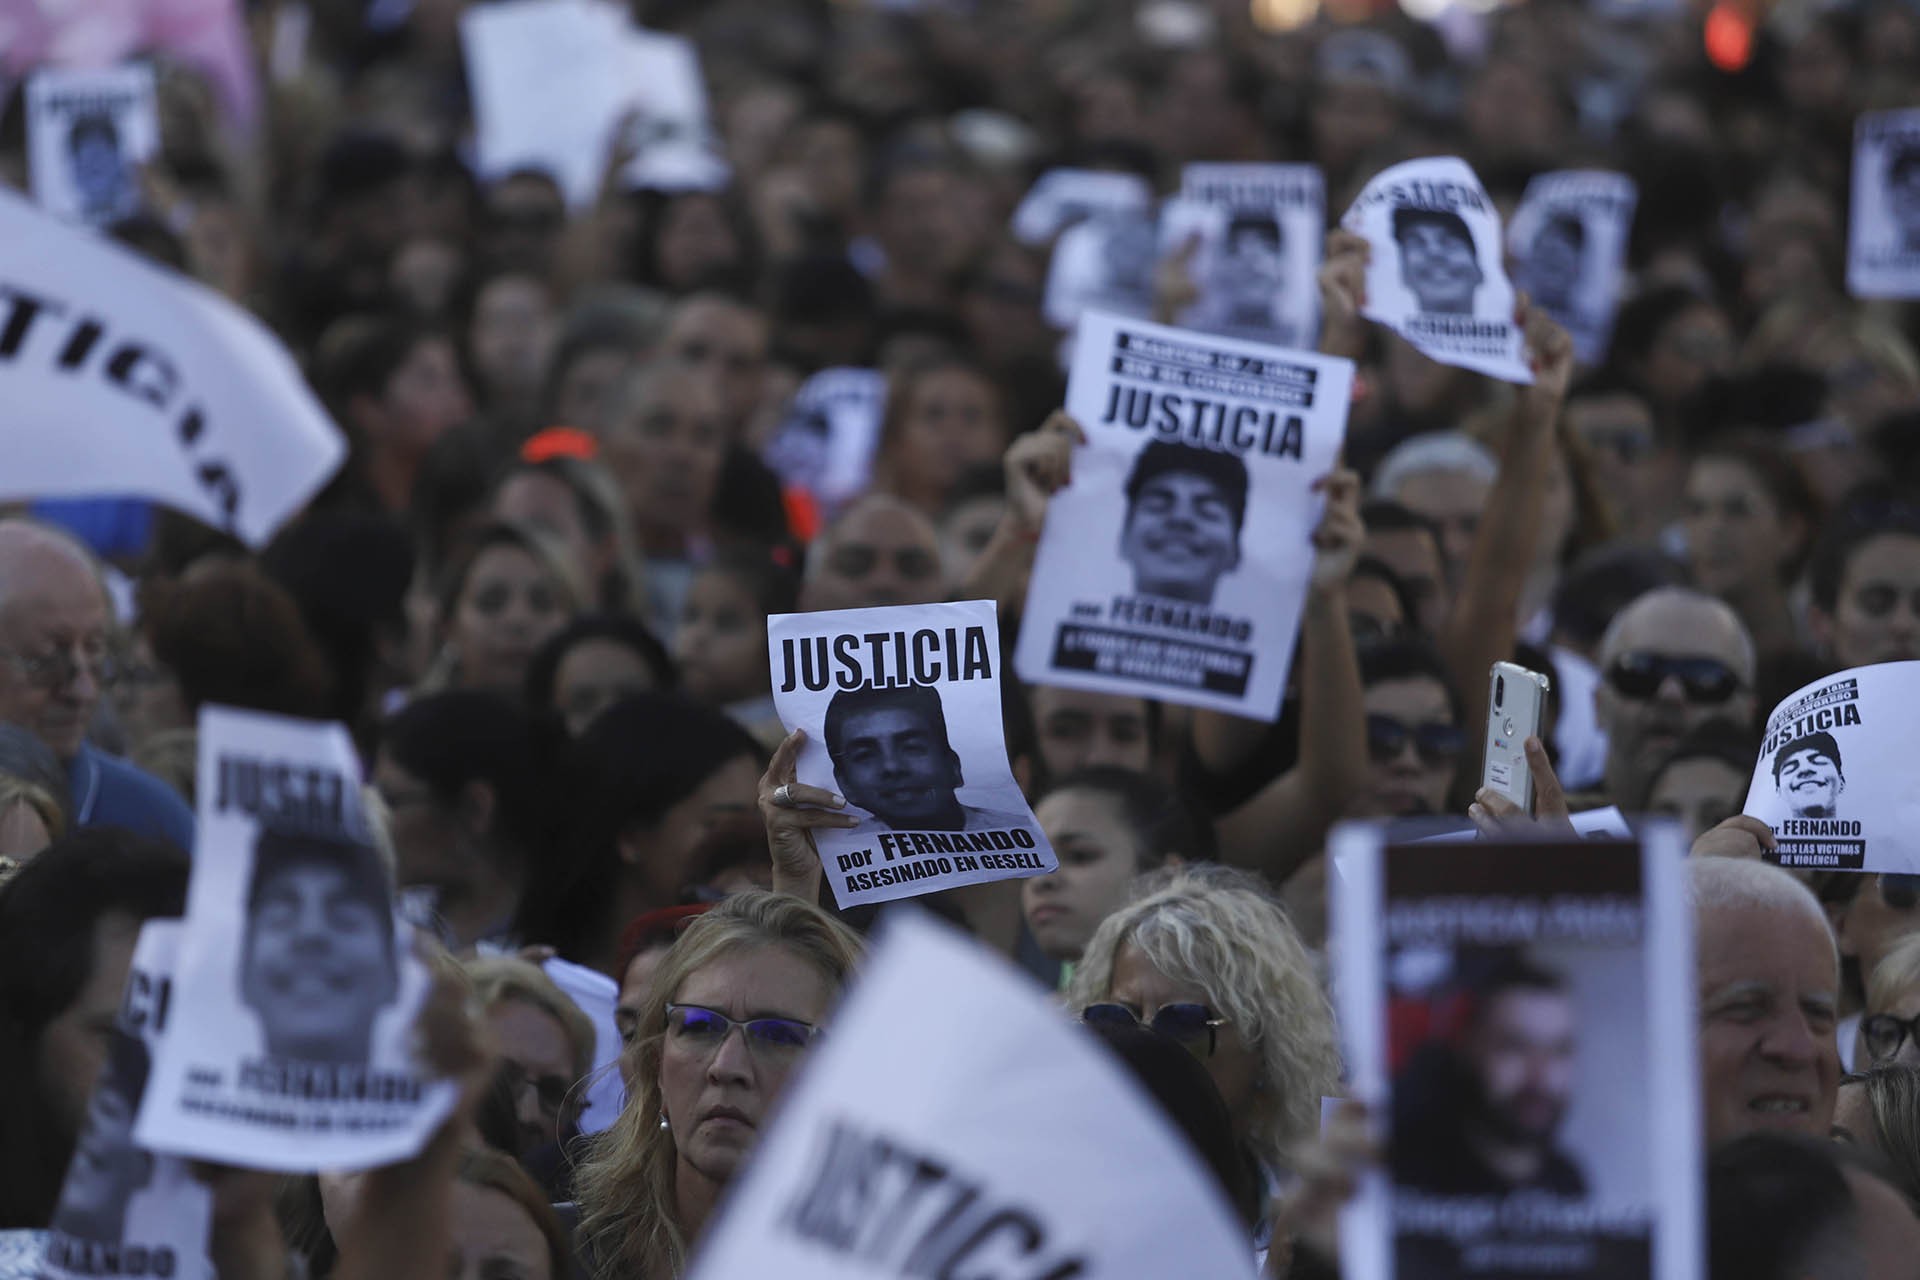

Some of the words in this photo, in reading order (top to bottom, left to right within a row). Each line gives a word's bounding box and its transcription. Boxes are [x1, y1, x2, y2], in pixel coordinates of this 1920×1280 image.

[1102, 384, 1305, 461] JUSTICIA
[1112, 597, 1253, 642] FERNANDO
[781, 626, 992, 693] JUSTICIA
[1760, 703, 1861, 761] JUSTICIA
[837, 849, 872, 873] por
[878, 828, 1036, 862] FERNANDO
[1783, 820, 1861, 836] FERNANDO
[1799, 843, 1815, 855] LAS
[1817, 843, 1860, 856] VICTIMAS
[845, 861, 952, 893] ASESINADO
[955, 855, 976, 873] EN
[980, 852, 1045, 871] GESELL
[1780, 854, 1792, 865] DE
[1793, 854, 1839, 866] VIOLENCIA
